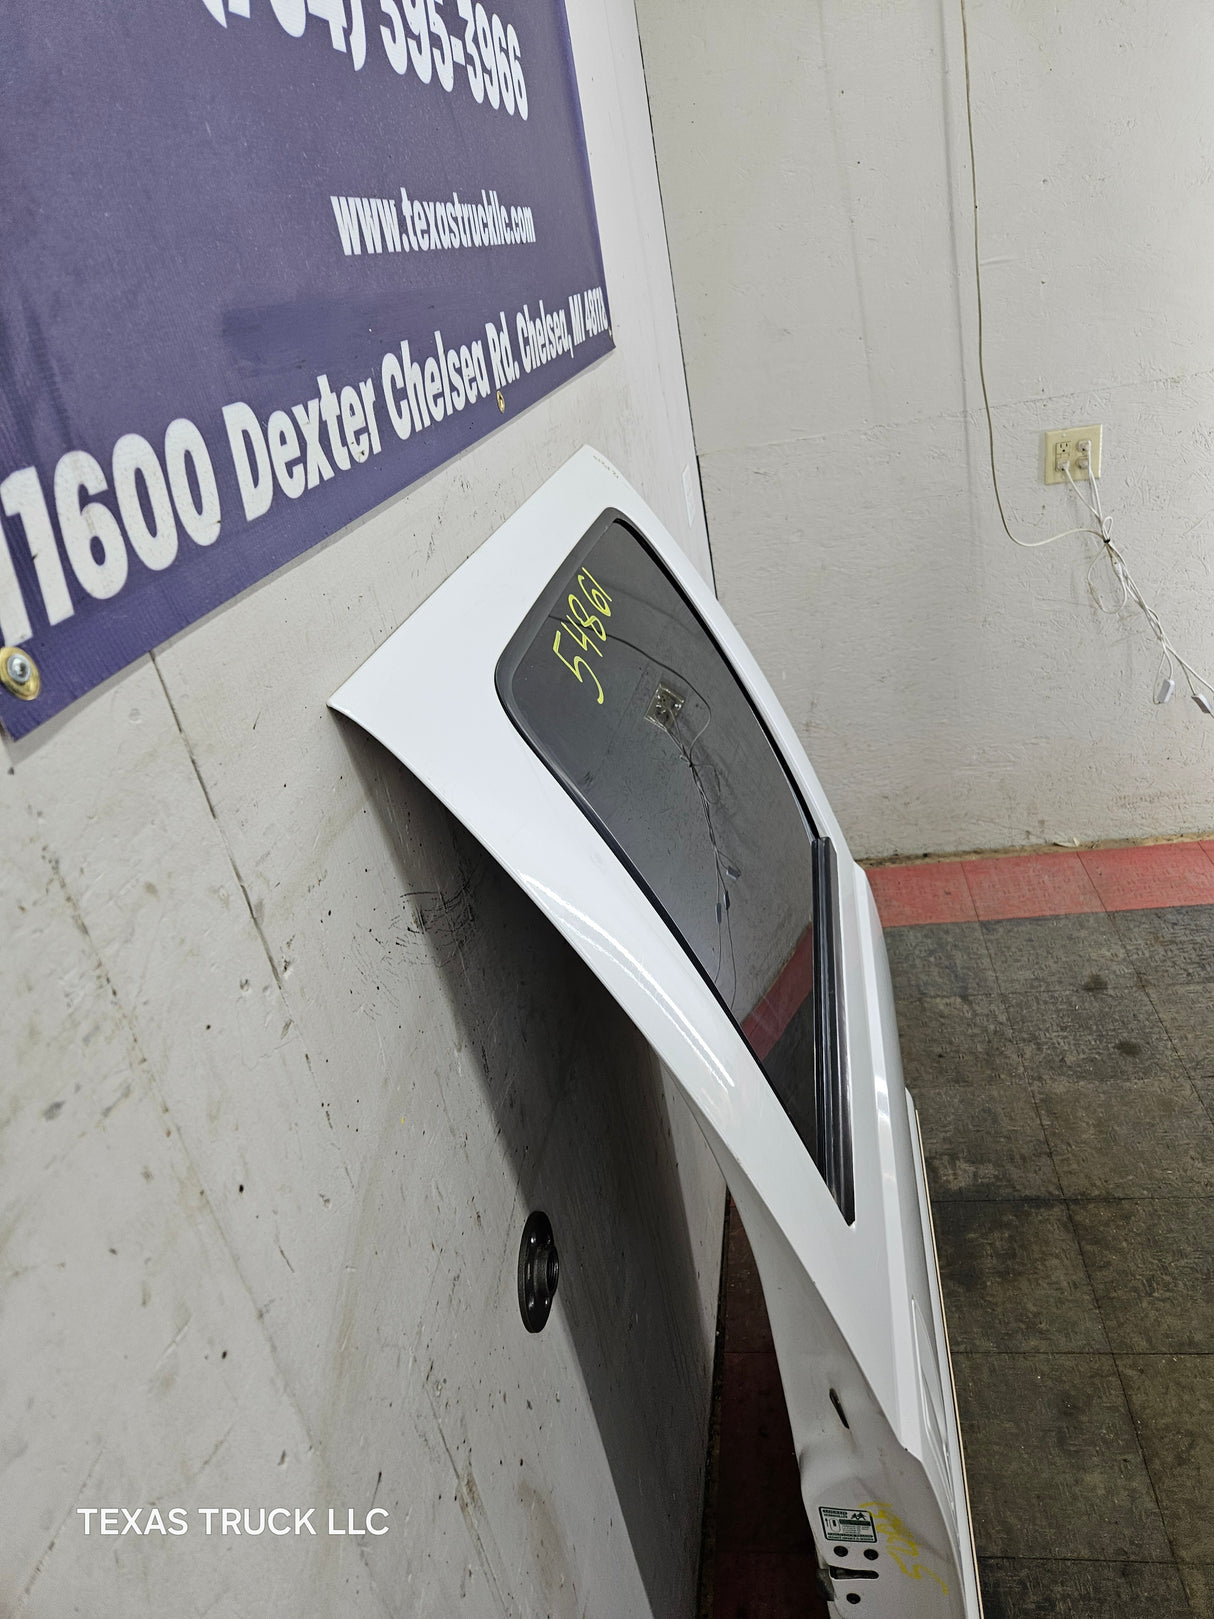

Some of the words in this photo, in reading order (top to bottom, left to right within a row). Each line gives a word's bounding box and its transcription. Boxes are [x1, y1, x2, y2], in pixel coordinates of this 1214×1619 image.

[379, 0, 528, 121] 395-3966
[330, 187, 536, 256] www.texastruckllc.com
[222, 375, 381, 521] Dexter
[381, 330, 490, 440] Chelsea
[485, 311, 520, 390] Rd.
[516, 299, 574, 374] Chelsea,
[568, 293, 585, 346] MI
[553, 567, 612, 704] 54861
